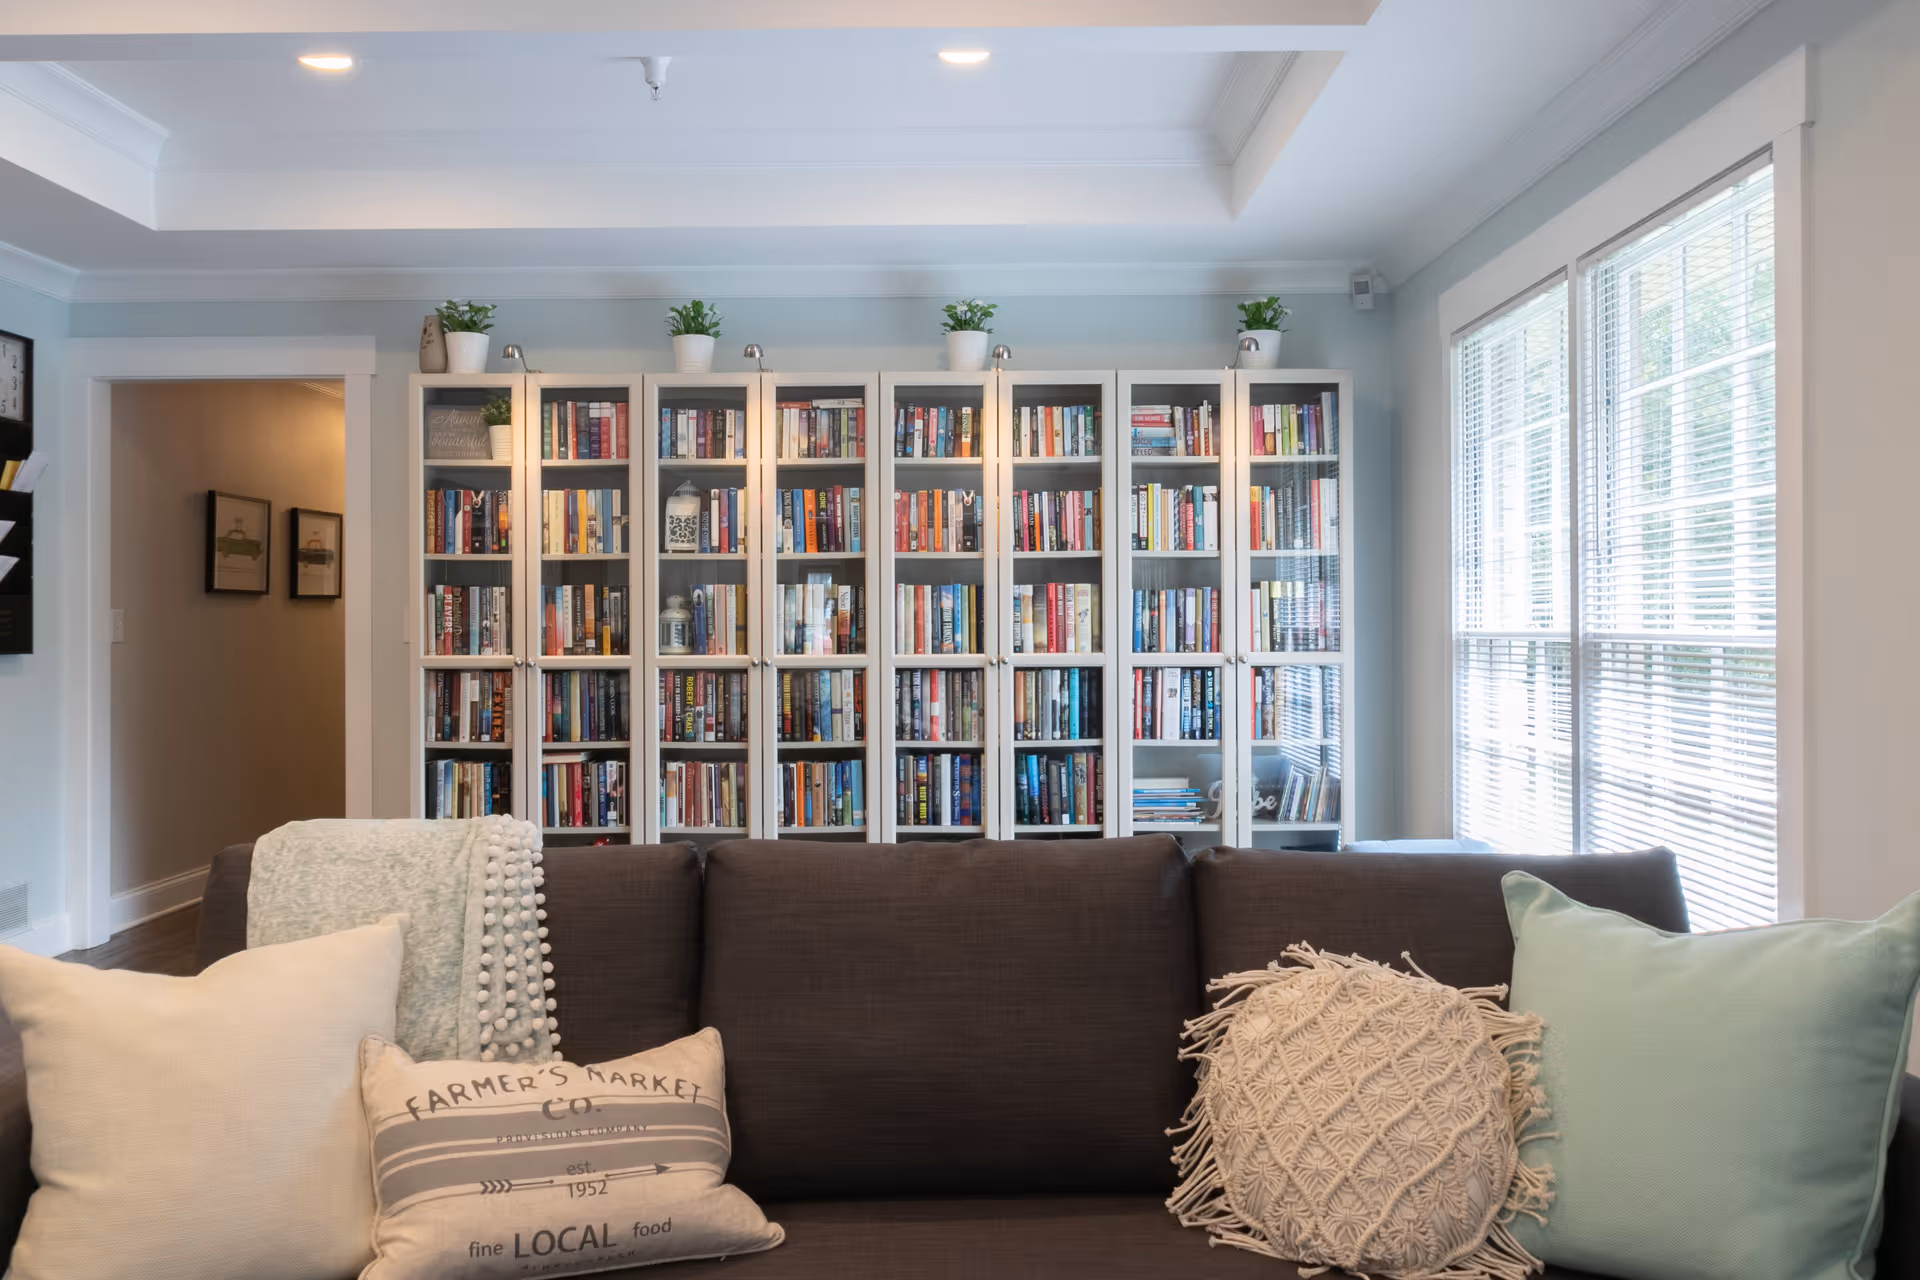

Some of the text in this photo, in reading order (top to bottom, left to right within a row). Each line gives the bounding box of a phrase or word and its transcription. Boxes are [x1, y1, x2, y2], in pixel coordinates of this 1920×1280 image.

[819, 492, 827, 509] GONE
[444, 593, 453, 634] PLAYERS
[685, 676, 694, 733] ROBERT CRAIS
[406, 1065, 702, 1122] FARMER'S MARKET
[542, 1096, 602, 1121] CO.
[566, 1160, 597, 1176] est.
[568, 1179, 609, 1198] 1952
[468, 1216, 672, 1259] fine LOCAL food
